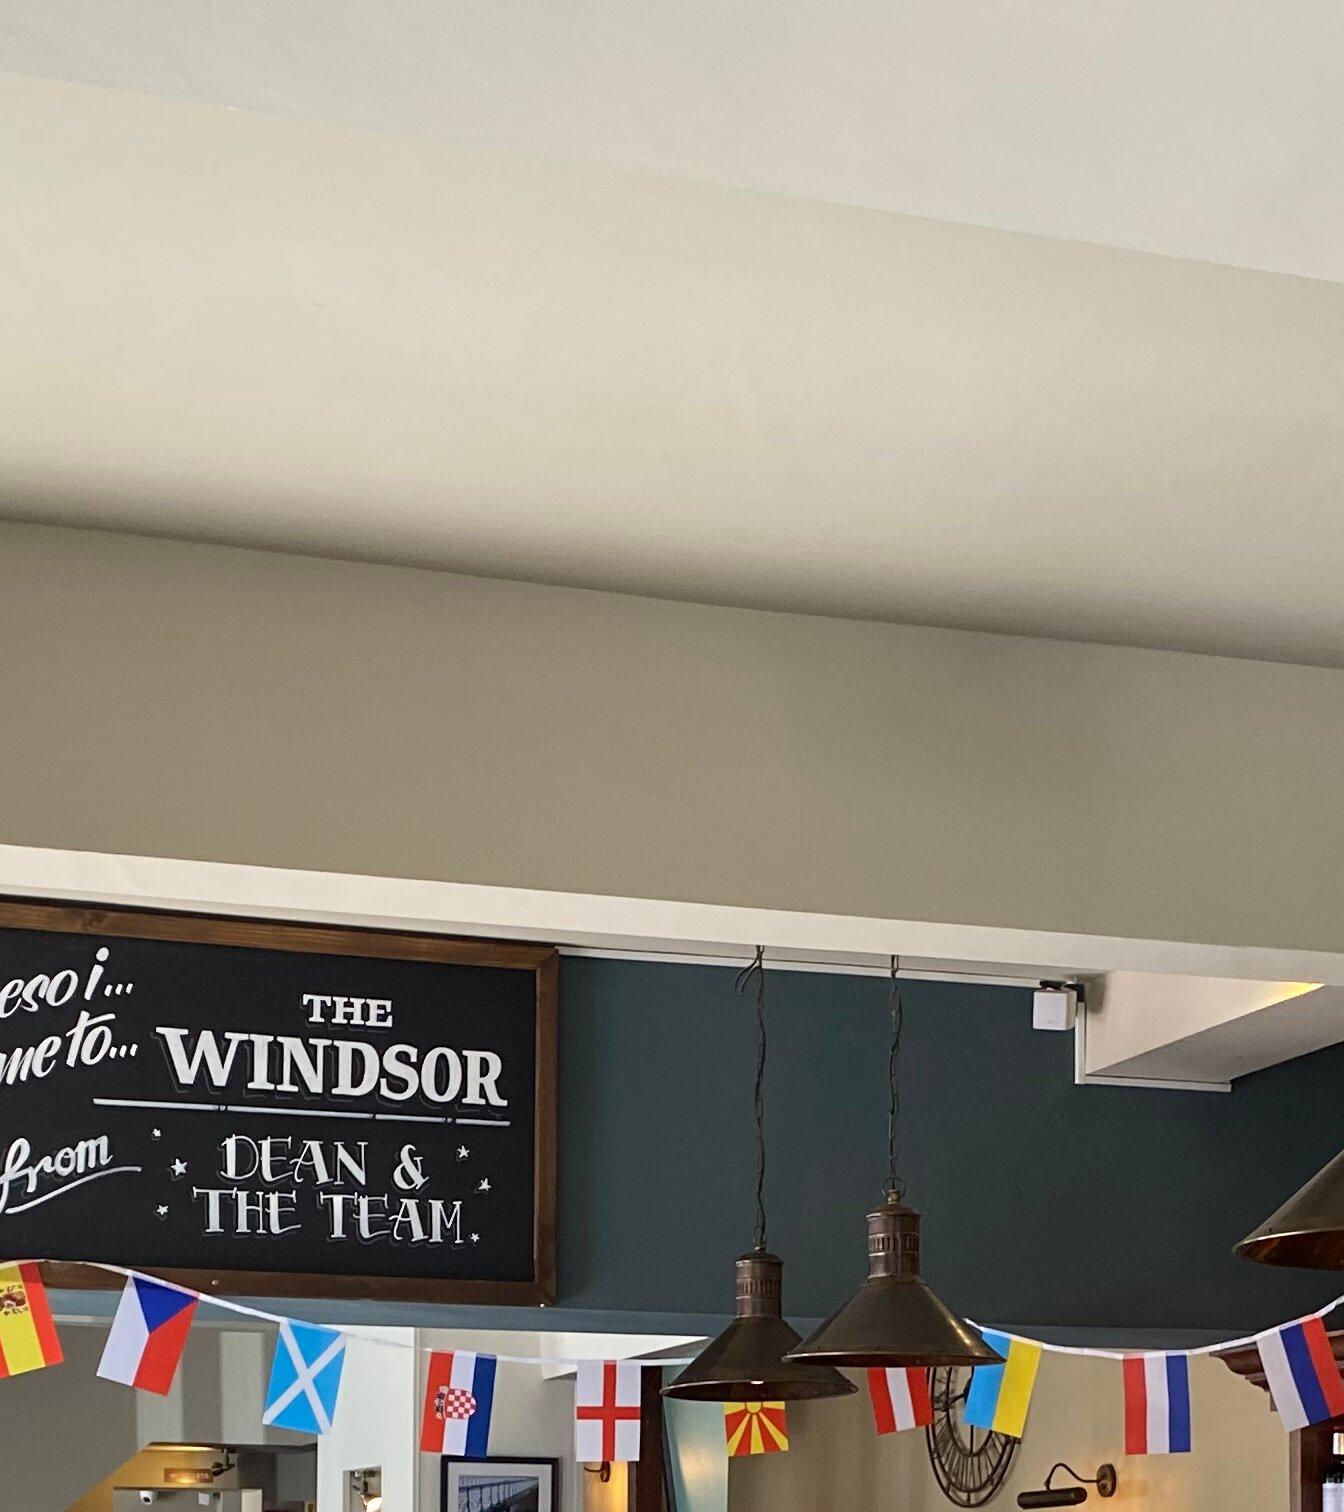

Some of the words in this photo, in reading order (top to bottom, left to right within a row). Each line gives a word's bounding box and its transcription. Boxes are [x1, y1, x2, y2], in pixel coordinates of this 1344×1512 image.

[302, 993, 393, 1028] THE
[156, 1026, 508, 1107] WINDSOR
[219, 1134, 368, 1186] DEAN
[393, 1144, 429, 1190] &
[192, 1186, 302, 1234] THE
[320, 1191, 462, 1244] TEAM
